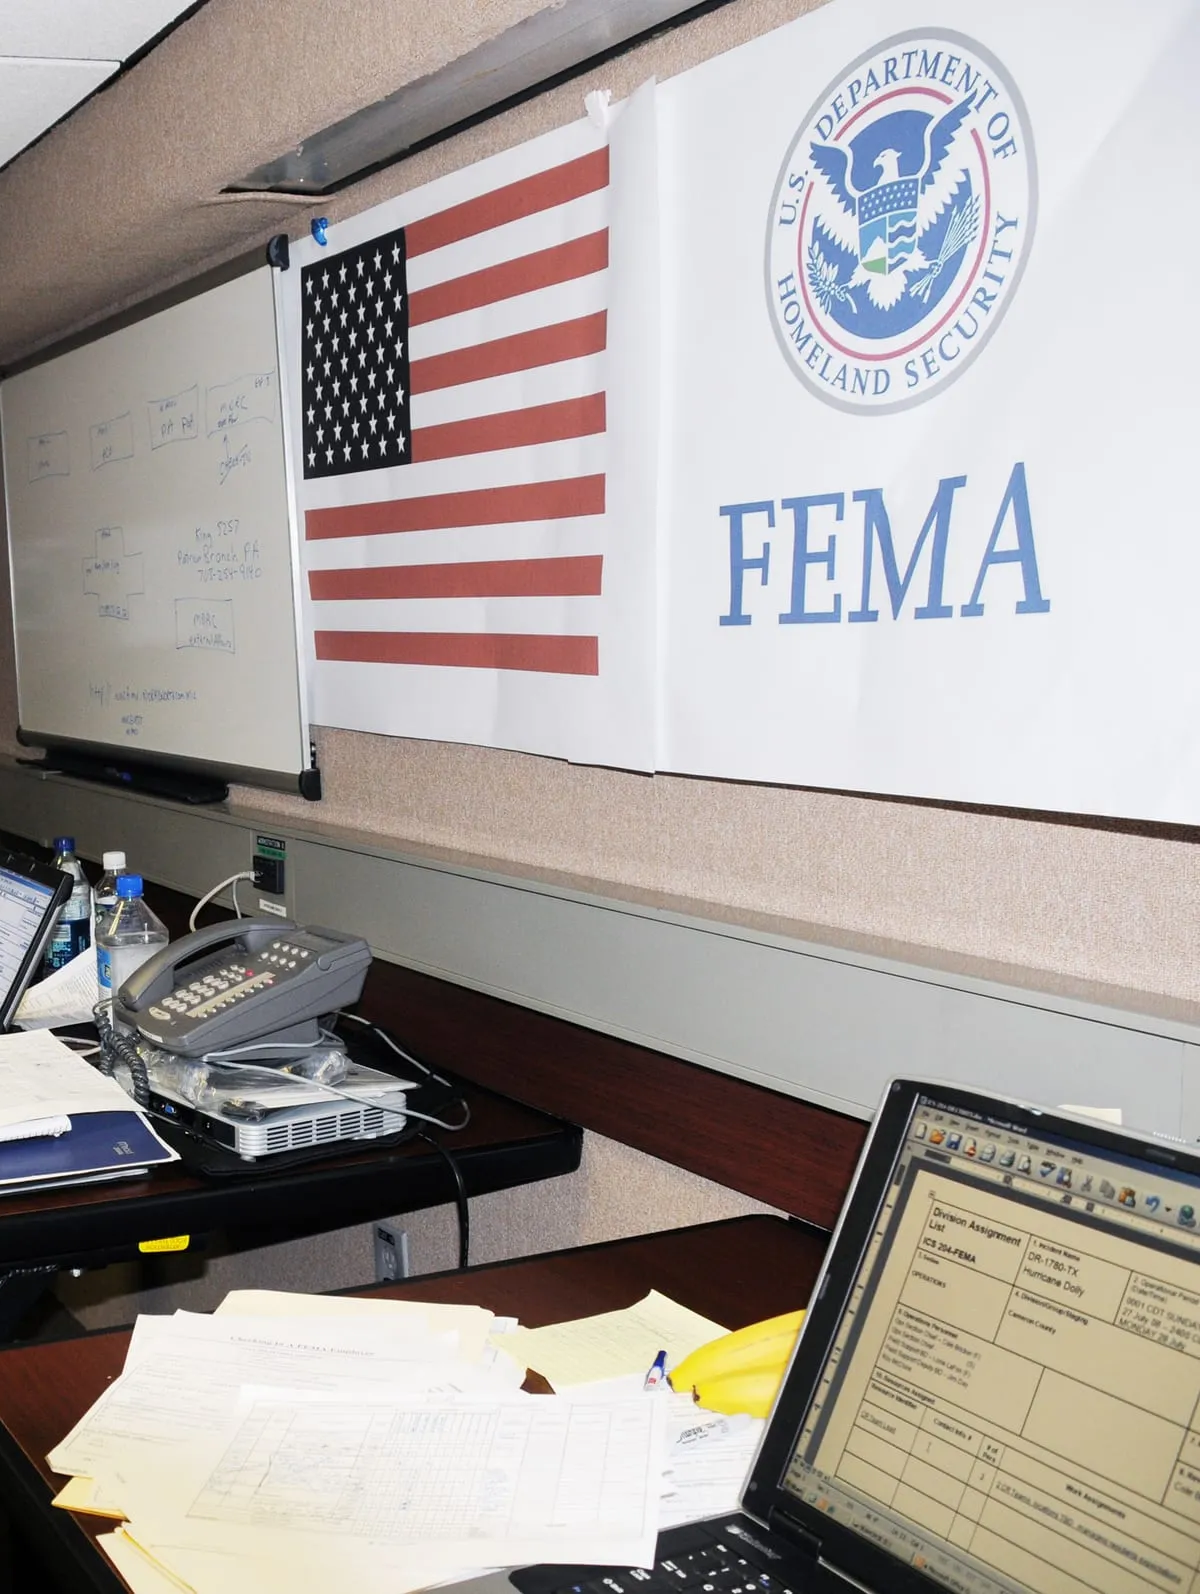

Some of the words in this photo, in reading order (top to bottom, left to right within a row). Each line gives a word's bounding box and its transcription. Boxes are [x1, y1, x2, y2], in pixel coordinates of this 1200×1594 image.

[779, 169, 808, 226] U.S.
[813, 49, 999, 142] DEPARTMENT
[987, 112, 1018, 160] OF
[777, 272, 891, 395] HOMELAND
[905, 211, 1019, 389] SECURITY
[719, 462, 1050, 626] FEMA
[929, 1219, 946, 1232] List
[933, 1207, 967, 1226] Division
[968, 1220, 1022, 1247] Assignment
[923, 1237, 937, 1249] ICS
[938, 1241, 976, 1264] 204-FEMA
[1023, 1267, 1062, 1287] Hurricane
[1063, 1281, 1085, 1297] Dolly
[1146, 1305, 1165, 1317] CDT
[1034, 1319, 1057, 1335] County
